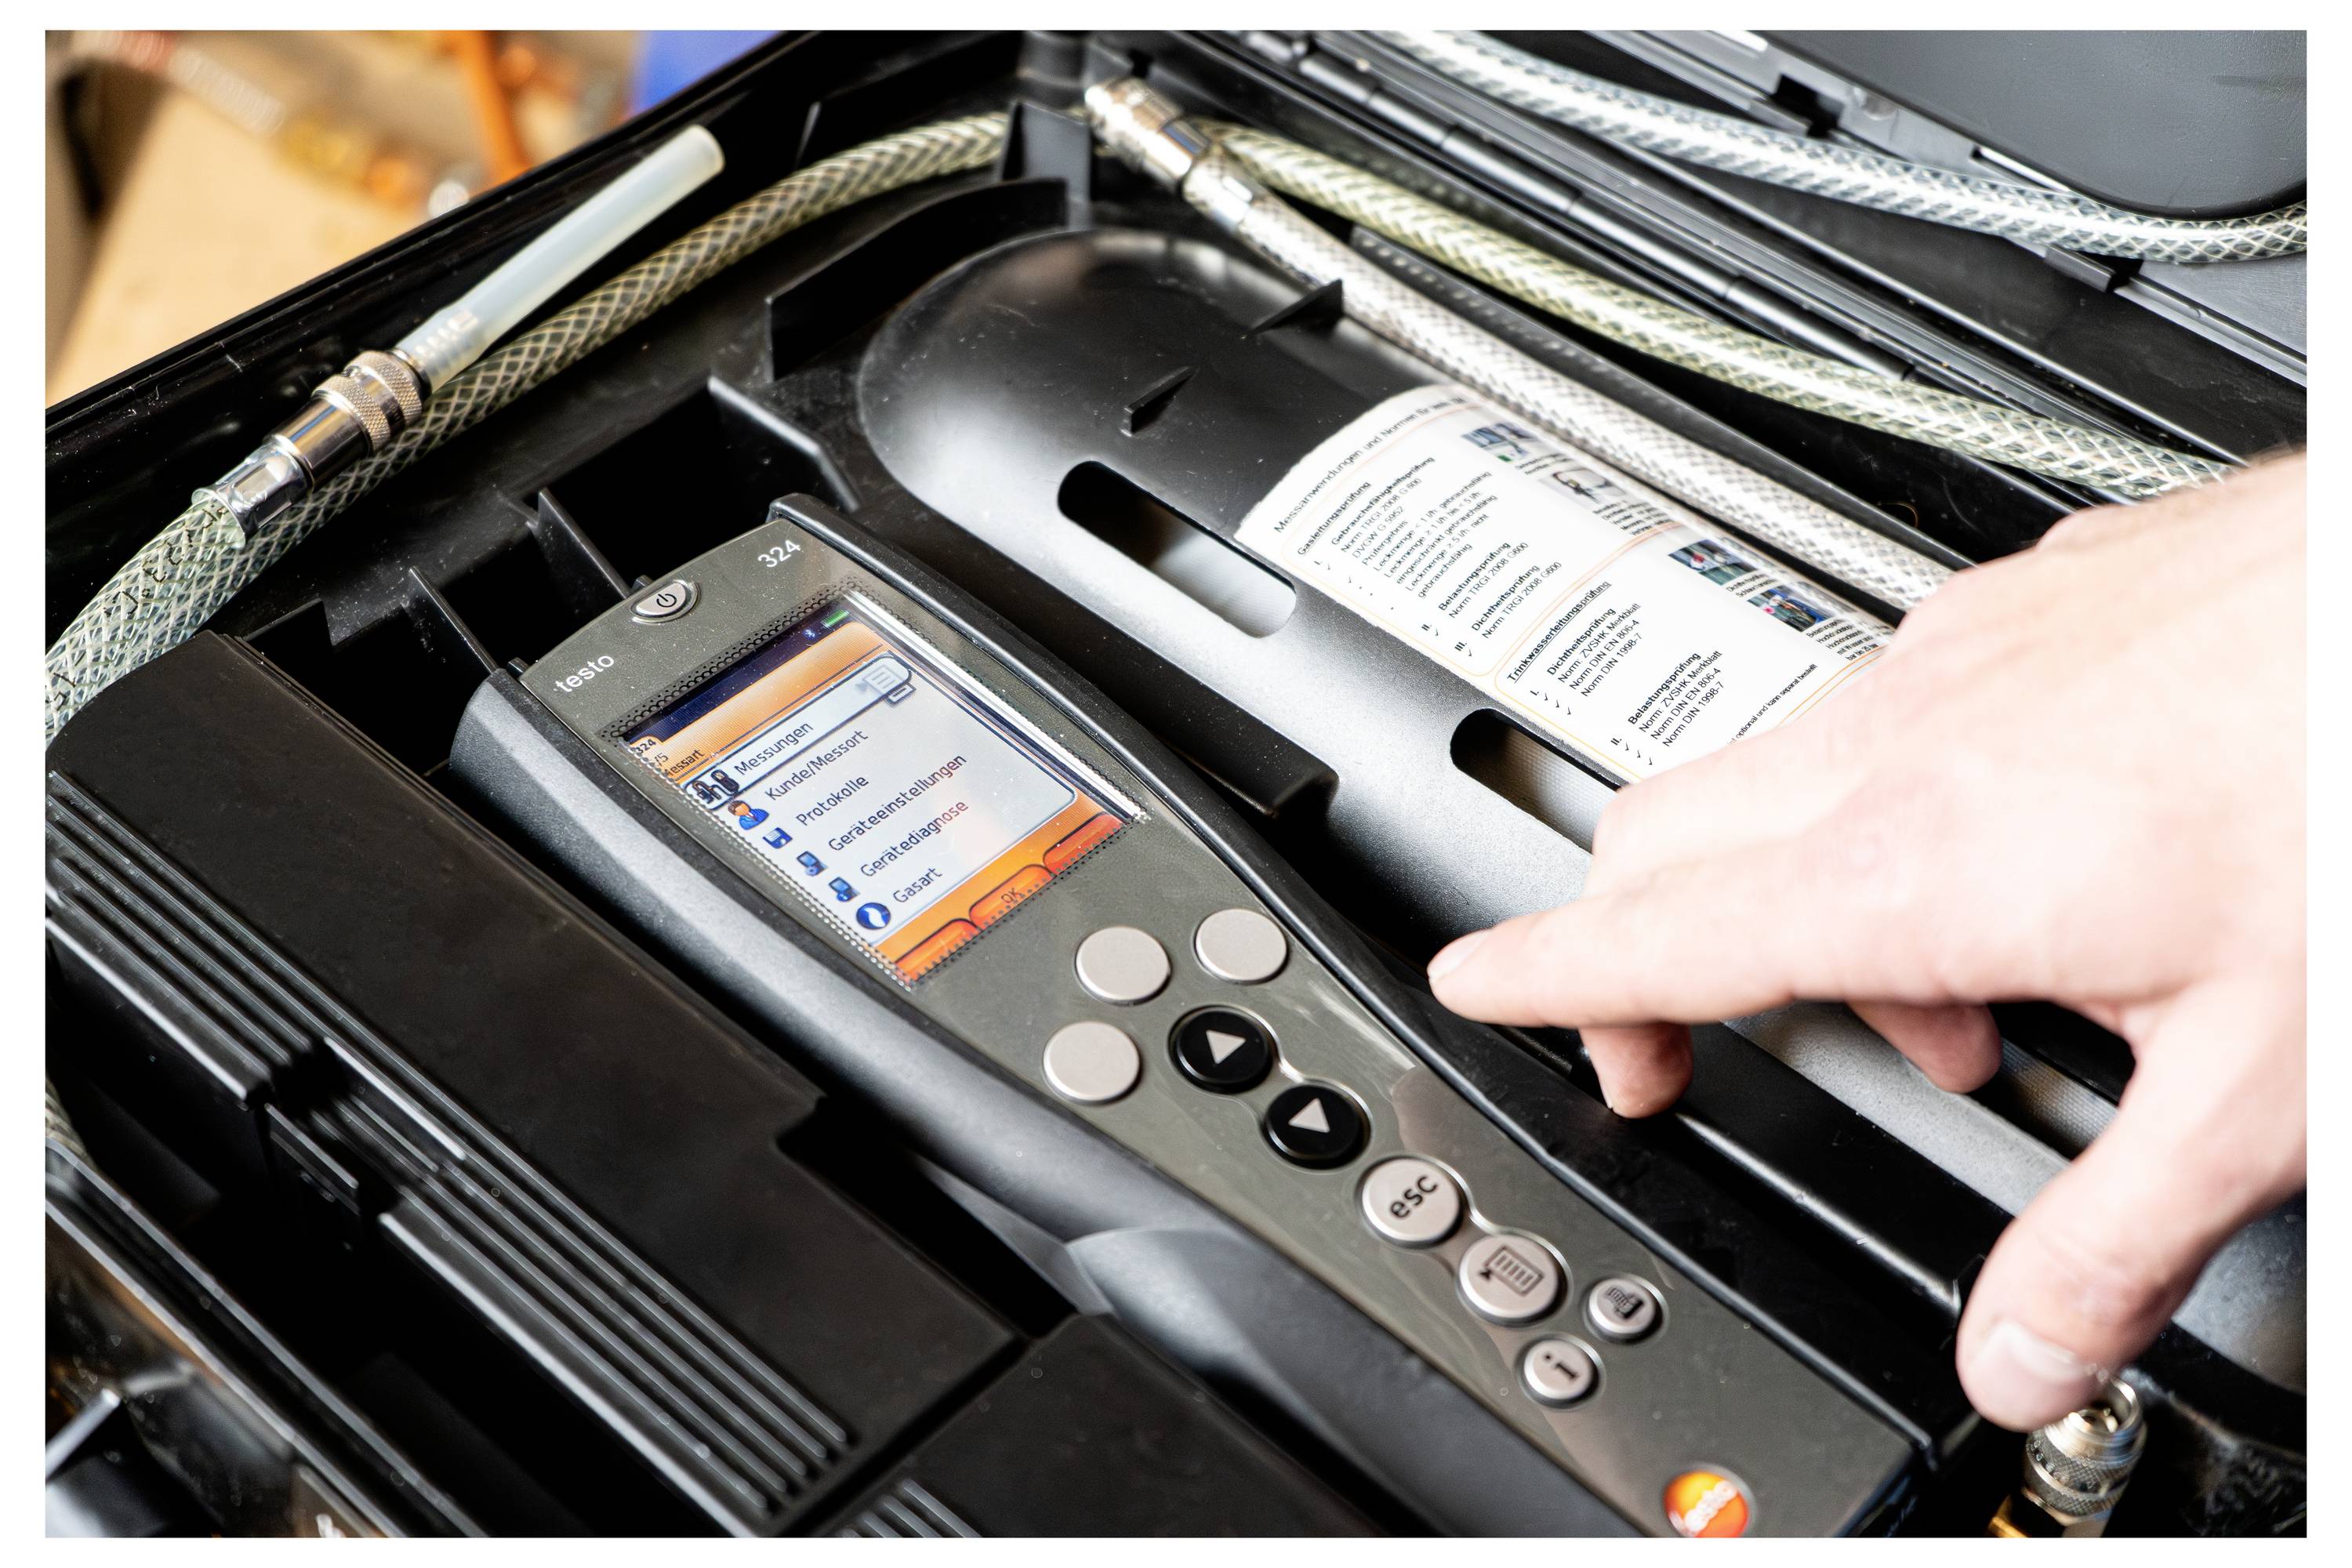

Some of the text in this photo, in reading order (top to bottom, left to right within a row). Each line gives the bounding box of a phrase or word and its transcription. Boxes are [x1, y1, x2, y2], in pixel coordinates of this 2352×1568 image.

[1274, 449, 1363, 533] Messanwendungen
[1363, 435, 1383, 451] und
[1380, 414, 1418, 437] Normen
[1331, 457, 1436, 545] Gebrauchsfähigkeitsprüfung
[1298, 481, 1371, 556] Gasleitungsprüfung
[1341, 532, 1363, 553] Norm
[1362, 511, 1382, 530] TRGI
[1381, 495, 1401, 512] 2008
[1352, 506, 1405, 558] DVGW G 5952
[1362, 520, 1408, 566] Prüfergebnis
[1374, 529, 1415, 572] Leckmenge
[757, 539, 802, 569] 324
[1384, 535, 1426, 579] Leckmenge
[1396, 534, 1445, 585] eingeschränkt
[1405, 549, 1448, 591] Leckmenge
[1470, 513, 1490, 528] nicht
[1417, 543, 1472, 599] gebrauchsfähig
[1438, 542, 1511, 611] Belastungsprüfung
[1449, 542, 1529, 619] Norm TRGI 2008 G600
[1471, 564, 1541, 631] Dichtheitsprüfung
[1482, 561, 1563, 639] Norm TRGI 2008 G600
[1507, 581, 1612, 683] Trinkwasserleitungsprüfung
[1547, 608, 1617, 675] Dichtheitsprüfung
[1558, 603, 1641, 683] Norm: ZVSHK Merkblatt
[1569, 619, 1640, 690] Norm DIN EN 806-4
[1581, 633, 1642, 697] Norm DIN 1998-7
[554, 651, 615, 695] testo
[1628, 653, 1701, 724] Belastungsprüfung
[1639, 650, 1722, 732] Norm: ZVSHK Merkblatt
[1650, 667, 1721, 739] Norm DIN EN 806-4
[1662, 681, 1724, 747] Norm DIN 1998-7
[1735, 715, 1758, 739] optional
[1756, 705, 1769, 717] und
[1766, 695, 1781, 706] kann
[1780, 679, 1800, 695] separat
[630, 739, 657, 753] 324
[734, 722, 814, 775] Messungen
[764, 729, 869, 800] Kunde/Messort
[796, 775, 869, 826] Protokolle
[828, 755, 967, 851] Geräteeinstellungen
[860, 800, 970, 877] Gerätediagnose
[893, 867, 942, 903] Gasart
[1000, 887, 1020, 904] OK
[1389, 1174, 1439, 1220] esc
